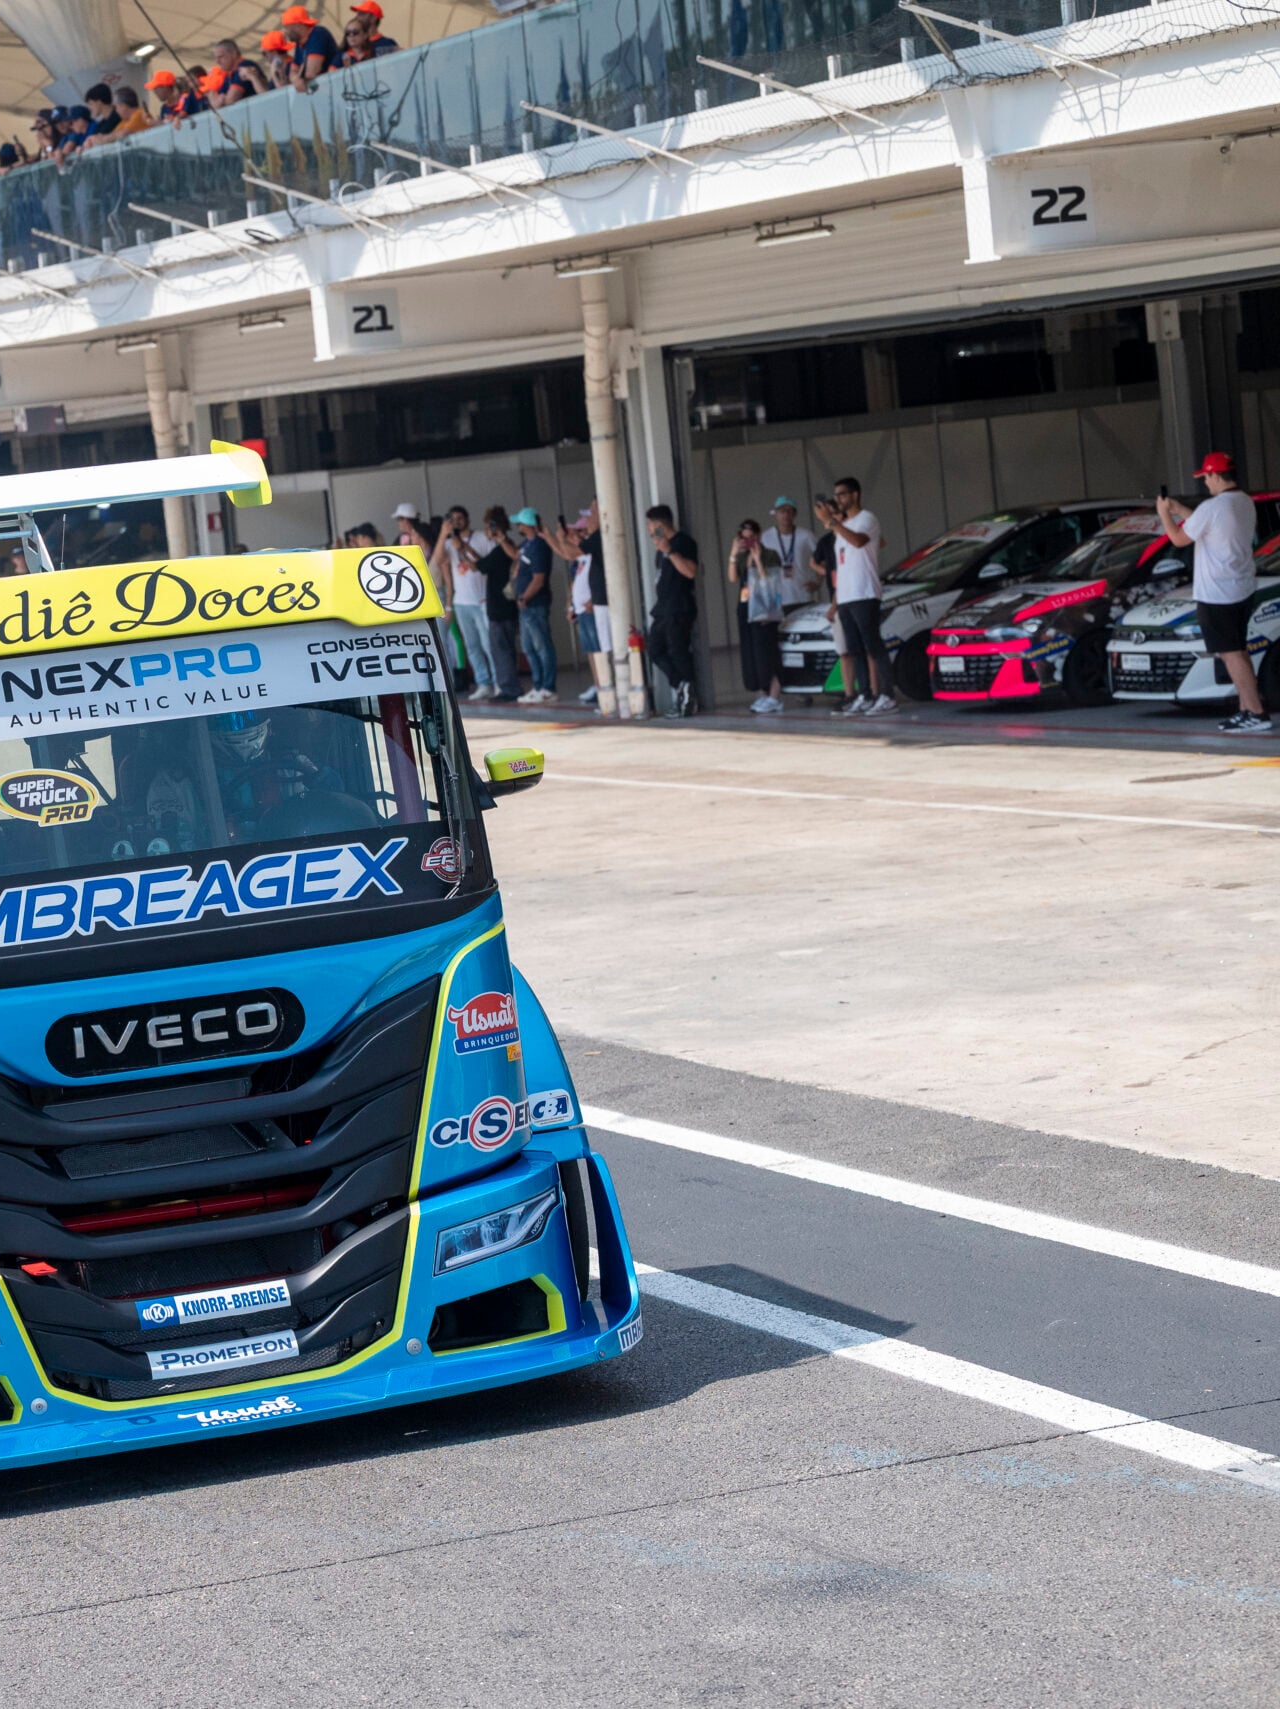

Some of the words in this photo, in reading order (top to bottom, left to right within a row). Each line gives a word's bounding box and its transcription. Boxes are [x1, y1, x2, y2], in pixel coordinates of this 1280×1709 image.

[1031, 186, 1087, 226] 22
[352, 304, 394, 333] 21
[110, 564, 321, 633] Doces
[307, 632, 432, 656] CONSÓRCIO
[0, 642, 262, 703] NEXPRO
[310, 652, 436, 684] IVECO
[10, 695, 170, 728] AUTHENTIC
[184, 683, 268, 706] VALUE
[7, 778, 55, 795] SUPER
[16, 786, 80, 808] TRUCK
[45, 803, 89, 824] PRO
[73, 1002, 278, 1059] IVECO
[449, 996, 514, 1034] Usual
[463, 1031, 518, 1049] BRINQUEDOS
[181, 1285, 287, 1317] KNORR-BREMSE
[158, 1336, 293, 1370] PROMETEON
[177, 1395, 297, 1423] Usual
[200, 1407, 303, 1428] BRINQUEDOS
